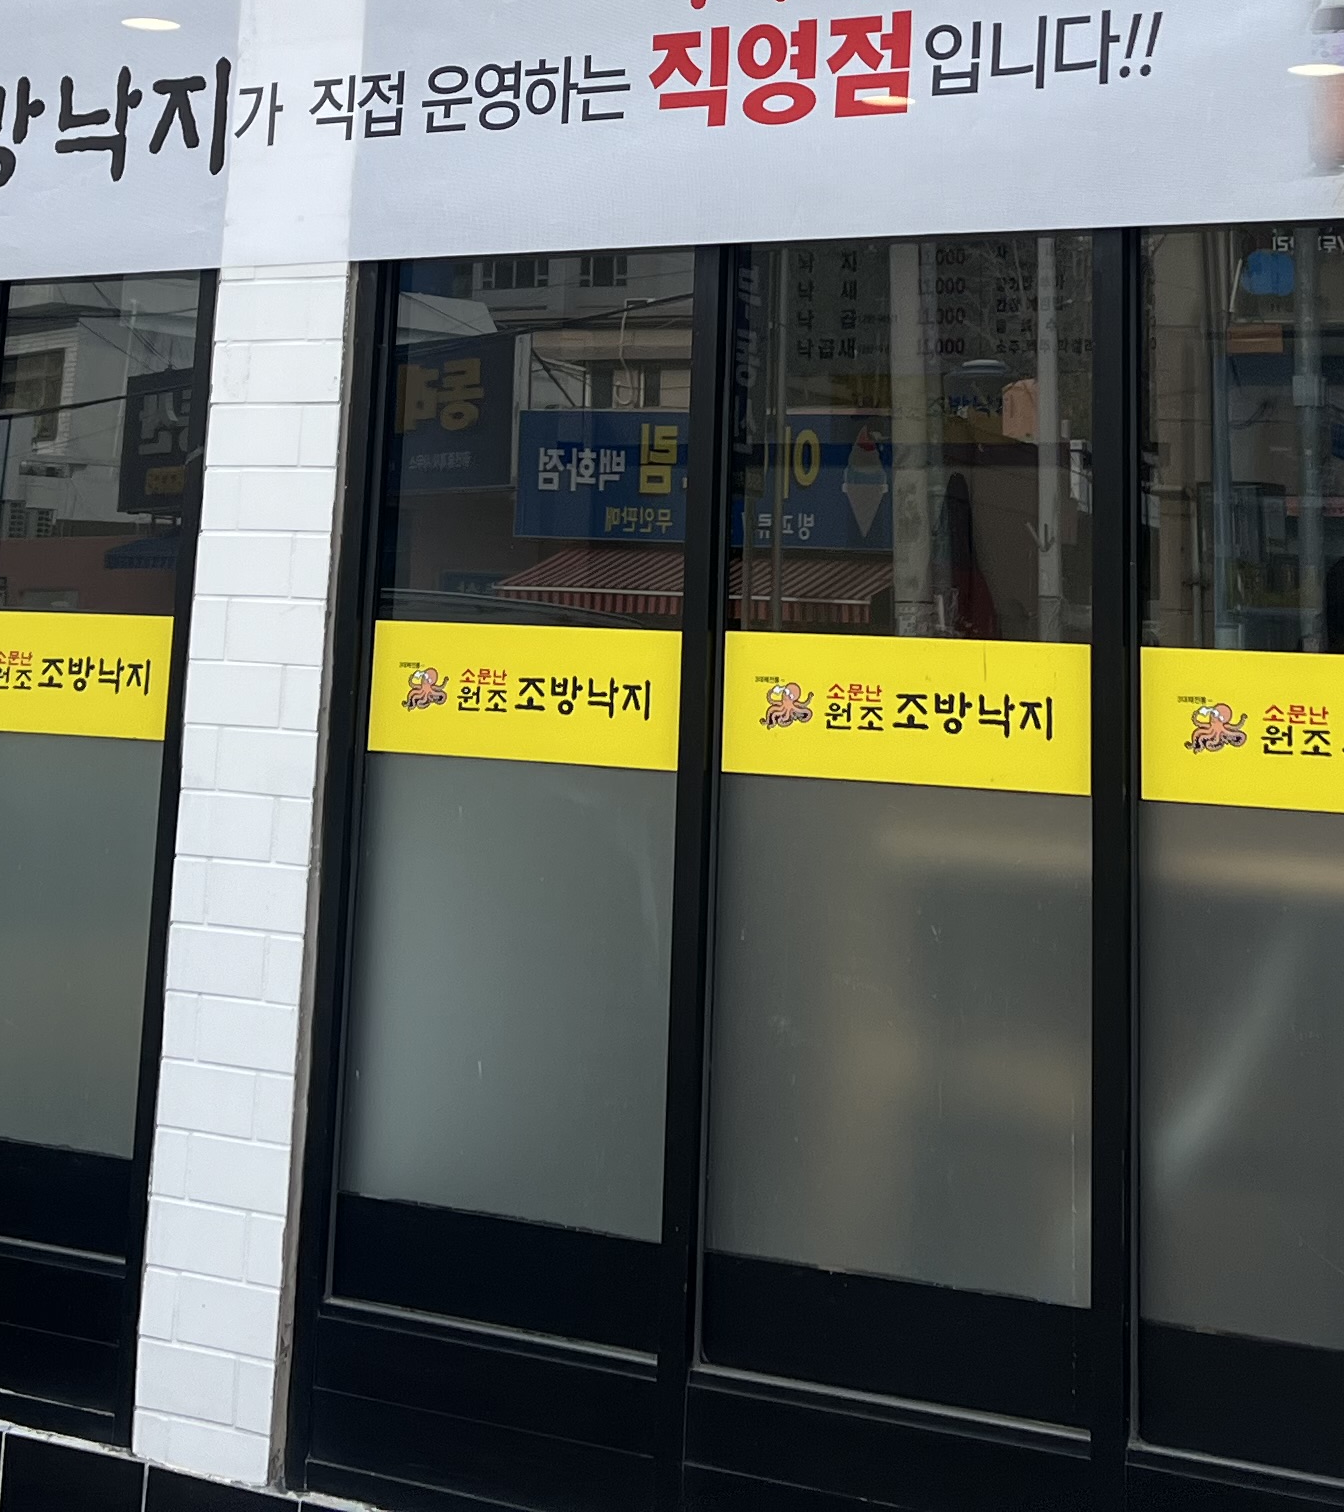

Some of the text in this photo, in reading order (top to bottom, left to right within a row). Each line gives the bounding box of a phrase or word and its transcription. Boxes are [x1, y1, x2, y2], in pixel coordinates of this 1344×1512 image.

[308, 70, 408, 143] 직접
[421, 54, 631, 137] 운영하는
[37, 655, 152, 696] 조방낙지
[458, 668, 508, 686] 소문난
[825, 683, 883, 702] 소문난
[456, 675, 652, 721] 원조 조방낙지
[824, 691, 1053, 741] 원조 조방낙지
[1262, 704, 1329, 726] 소문난
[1259, 724, 1332, 757] 원조
